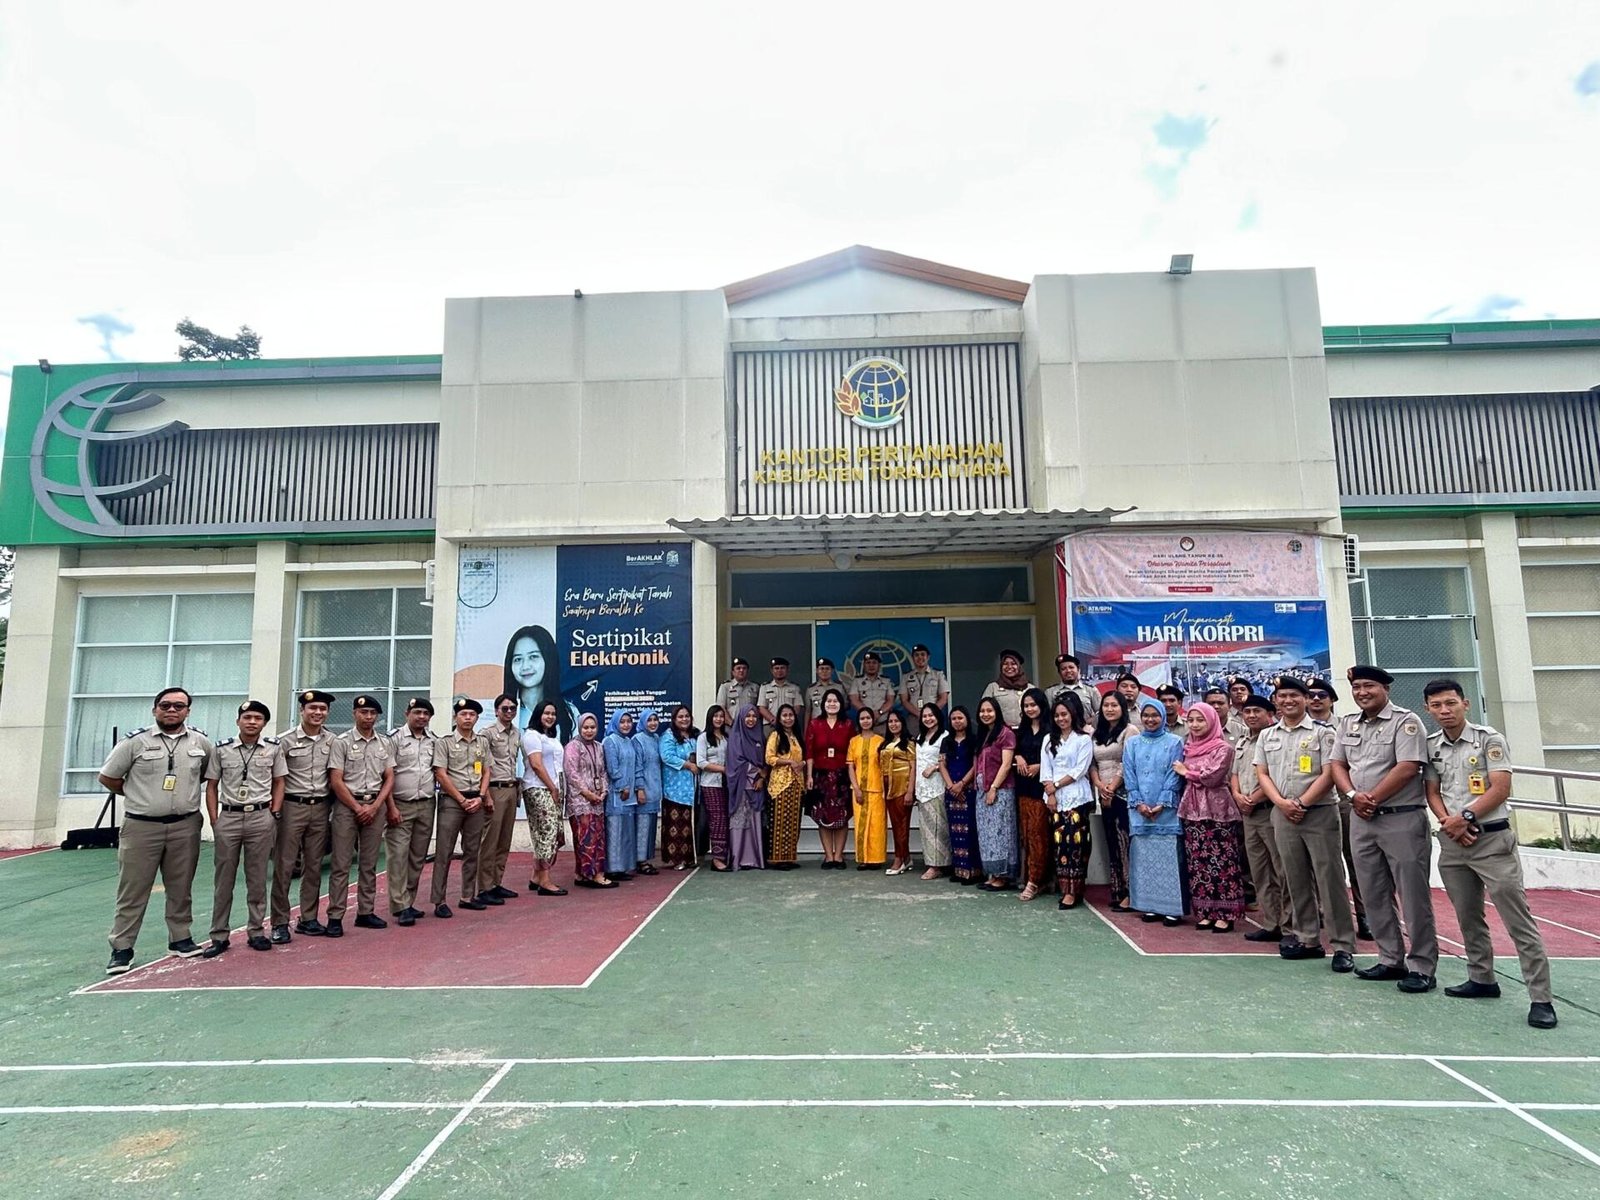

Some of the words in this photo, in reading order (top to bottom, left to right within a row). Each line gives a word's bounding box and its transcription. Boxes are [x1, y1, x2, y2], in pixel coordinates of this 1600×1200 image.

[761, 447, 849, 465] KANTOR
[857, 442, 1004, 463] PERTANAHAN
[753, 466, 864, 484] KABUPATEN
[869, 464, 943, 481] TORAJA
[948, 462, 1010, 478] UTARA
[626, 553, 663, 562] BerAKHLAK
[564, 588, 580, 601] Era
[583, 587, 604, 601] Baru
[606, 585, 647, 604] Sertipikat
[647, 585, 672, 601] Tanah
[563, 605, 596, 620] Saatnya
[599, 603, 631, 616] Beralih
[634, 603, 645, 616] Ke
[572, 628, 672, 652] Sertipikat
[1137, 625, 1183, 642] HARI
[1189, 625, 1265, 642] KORPRI
[570, 649, 670, 667] Elektronik
